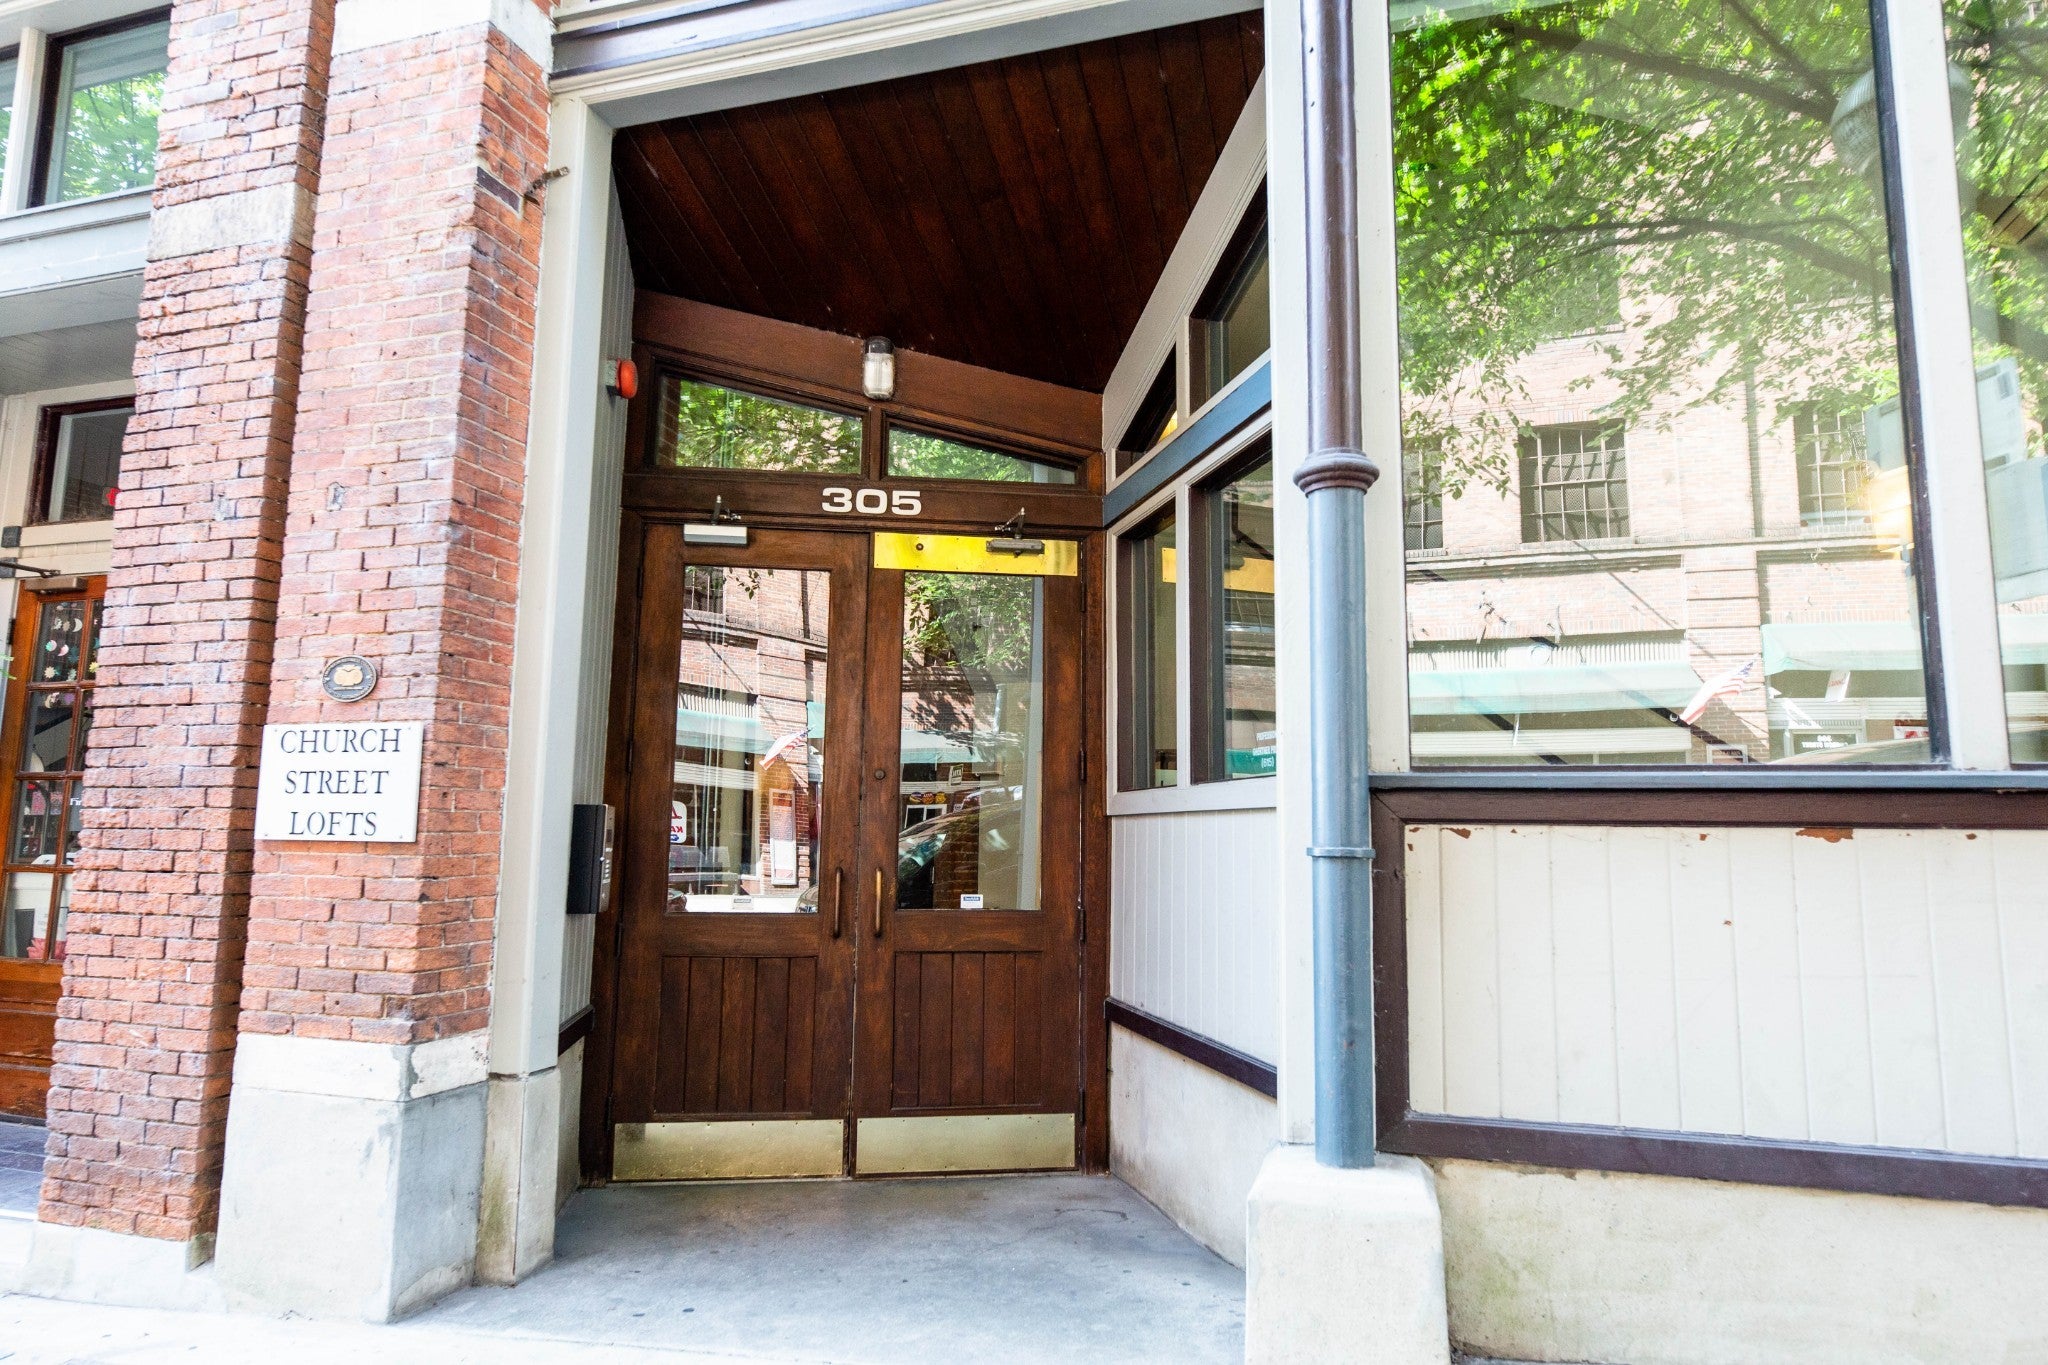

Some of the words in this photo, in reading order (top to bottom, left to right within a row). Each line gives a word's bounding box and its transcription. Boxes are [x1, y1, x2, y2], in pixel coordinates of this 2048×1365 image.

[821, 487, 922, 516] 305
[280, 728, 403, 753] CHURCH
[284, 770, 390, 794] STREET
[288, 811, 378, 836] LOFTS
